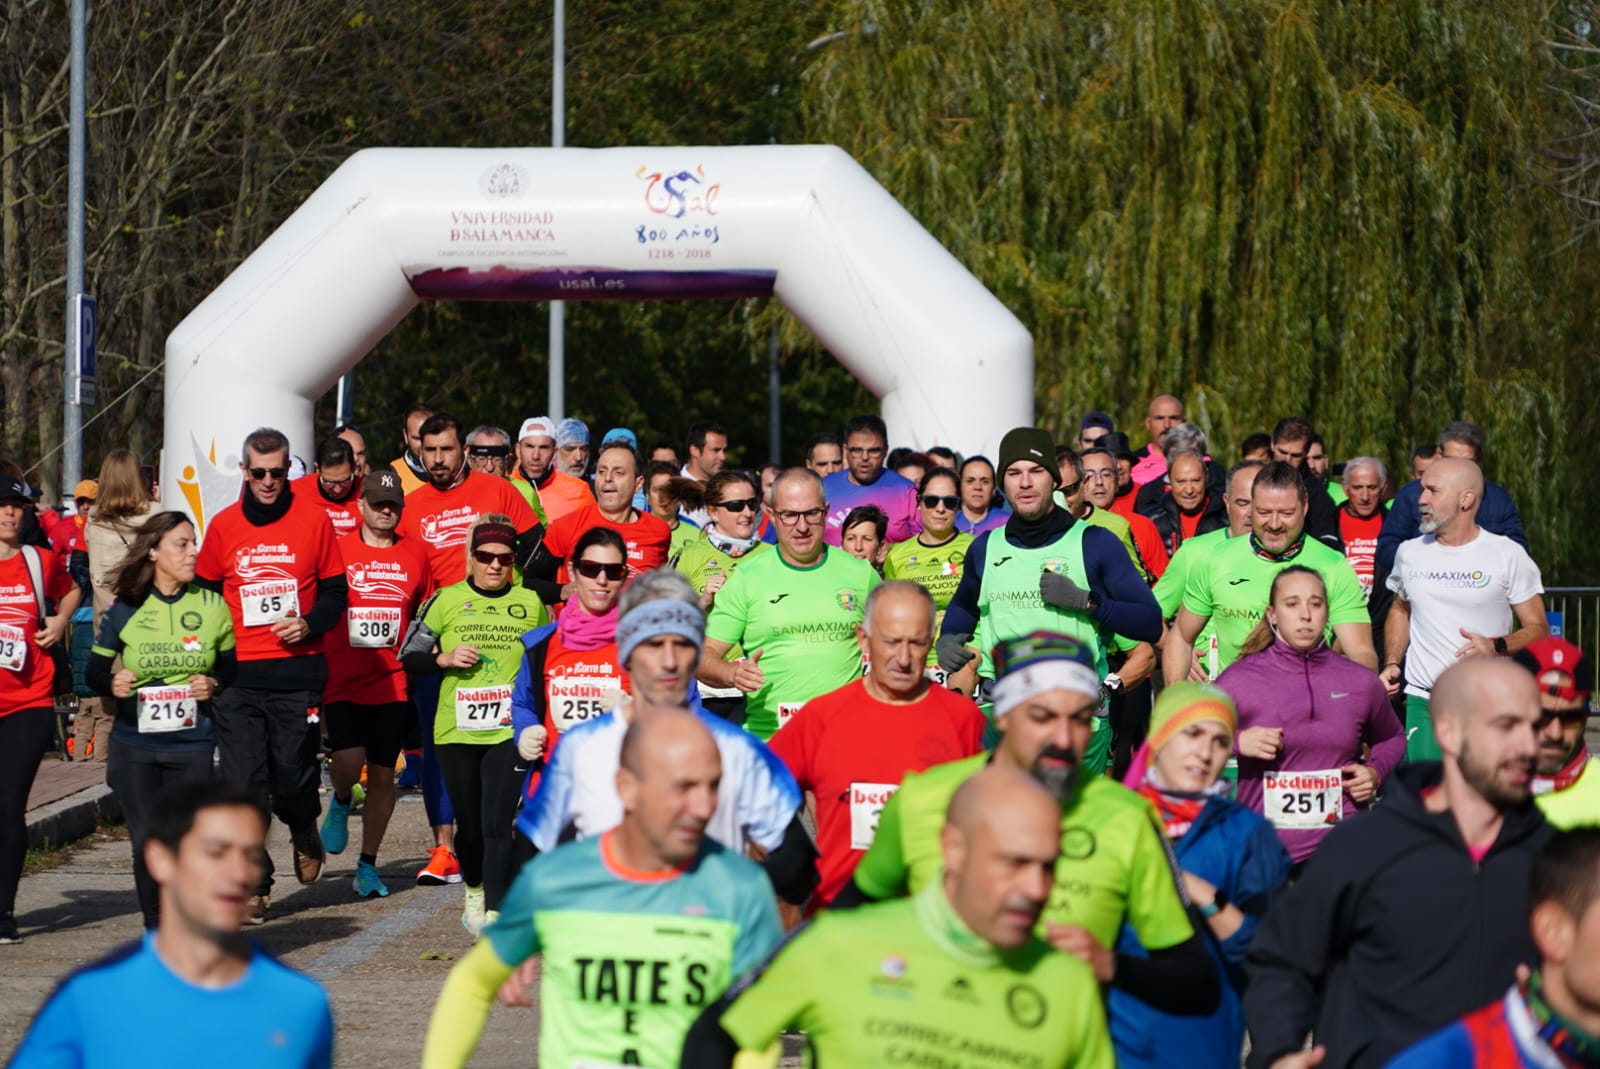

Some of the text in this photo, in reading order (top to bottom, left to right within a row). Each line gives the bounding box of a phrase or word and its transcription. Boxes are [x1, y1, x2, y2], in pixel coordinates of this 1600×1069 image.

[450, 211, 554, 225] VNIVERSIDAD
[635, 224, 720, 244] 800 AÑOS
[647, 248, 675, 259] 1218
[685, 248, 713, 259] 2018
[559, 276, 625, 289] usal.es
[242, 583, 295, 598] bedunia
[989, 590, 1042, 602] SANMAXI
[260, 596, 281, 613] 65
[1012, 600, 1045, 609] TELECO
[349, 610, 399, 621] bedunia
[1223, 608, 1261, 620] SANM
[360, 622, 390, 637] 308
[772, 621, 857, 637] SANMAXIMO
[461, 634, 520, 642] CARBAJOSA
[138, 656, 208, 669] CARBAJOSA
[457, 689, 511, 702] bedunia
[150, 703, 185, 720] 216
[467, 702, 501, 720] 277
[563, 700, 603, 720] 255
[1266, 774, 1340, 790] bedunia
[1282, 792, 1325, 814] 251
